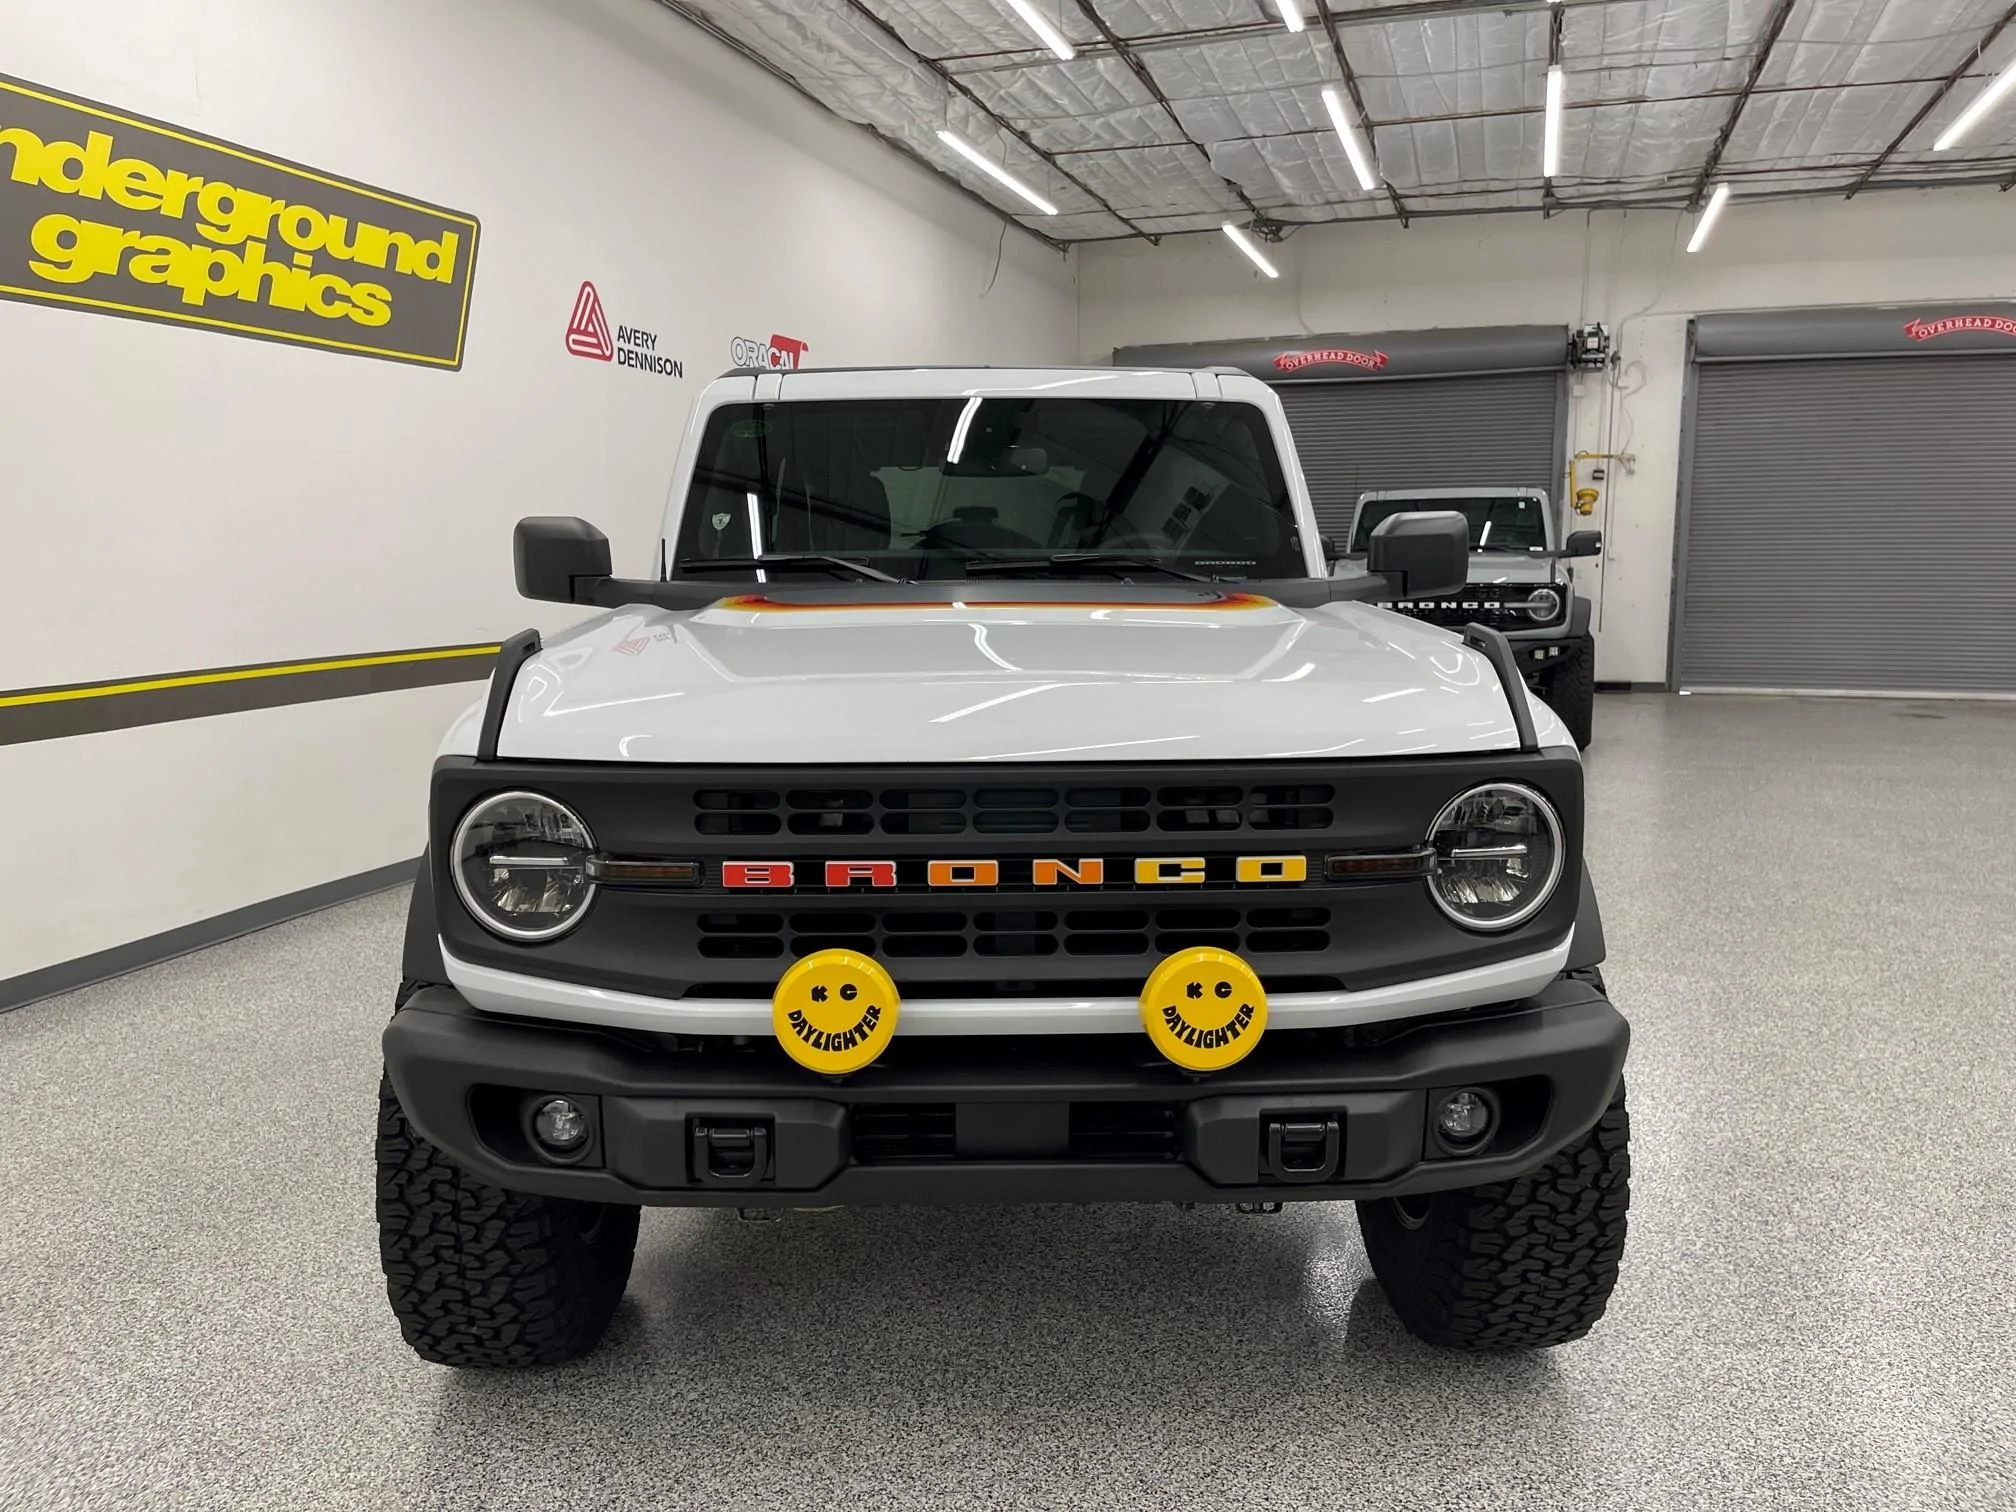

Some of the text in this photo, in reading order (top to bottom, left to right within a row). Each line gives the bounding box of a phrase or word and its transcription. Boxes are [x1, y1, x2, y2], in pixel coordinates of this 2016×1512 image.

[0, 127, 459, 284] nderground
[29, 214, 392, 326] graphics
[617, 325, 657, 350] AVERY
[1919, 318, 1991, 337] OVERHEAD
[617, 347, 683, 378] DENNISON
[1286, 350, 1375, 369] OVERHEAD DOOR
[722, 855, 1307, 888] BRONCO
[788, 1005, 882, 1052] DAYLIGHTER
[1162, 1003, 1255, 1049] DAYLIGHTER
